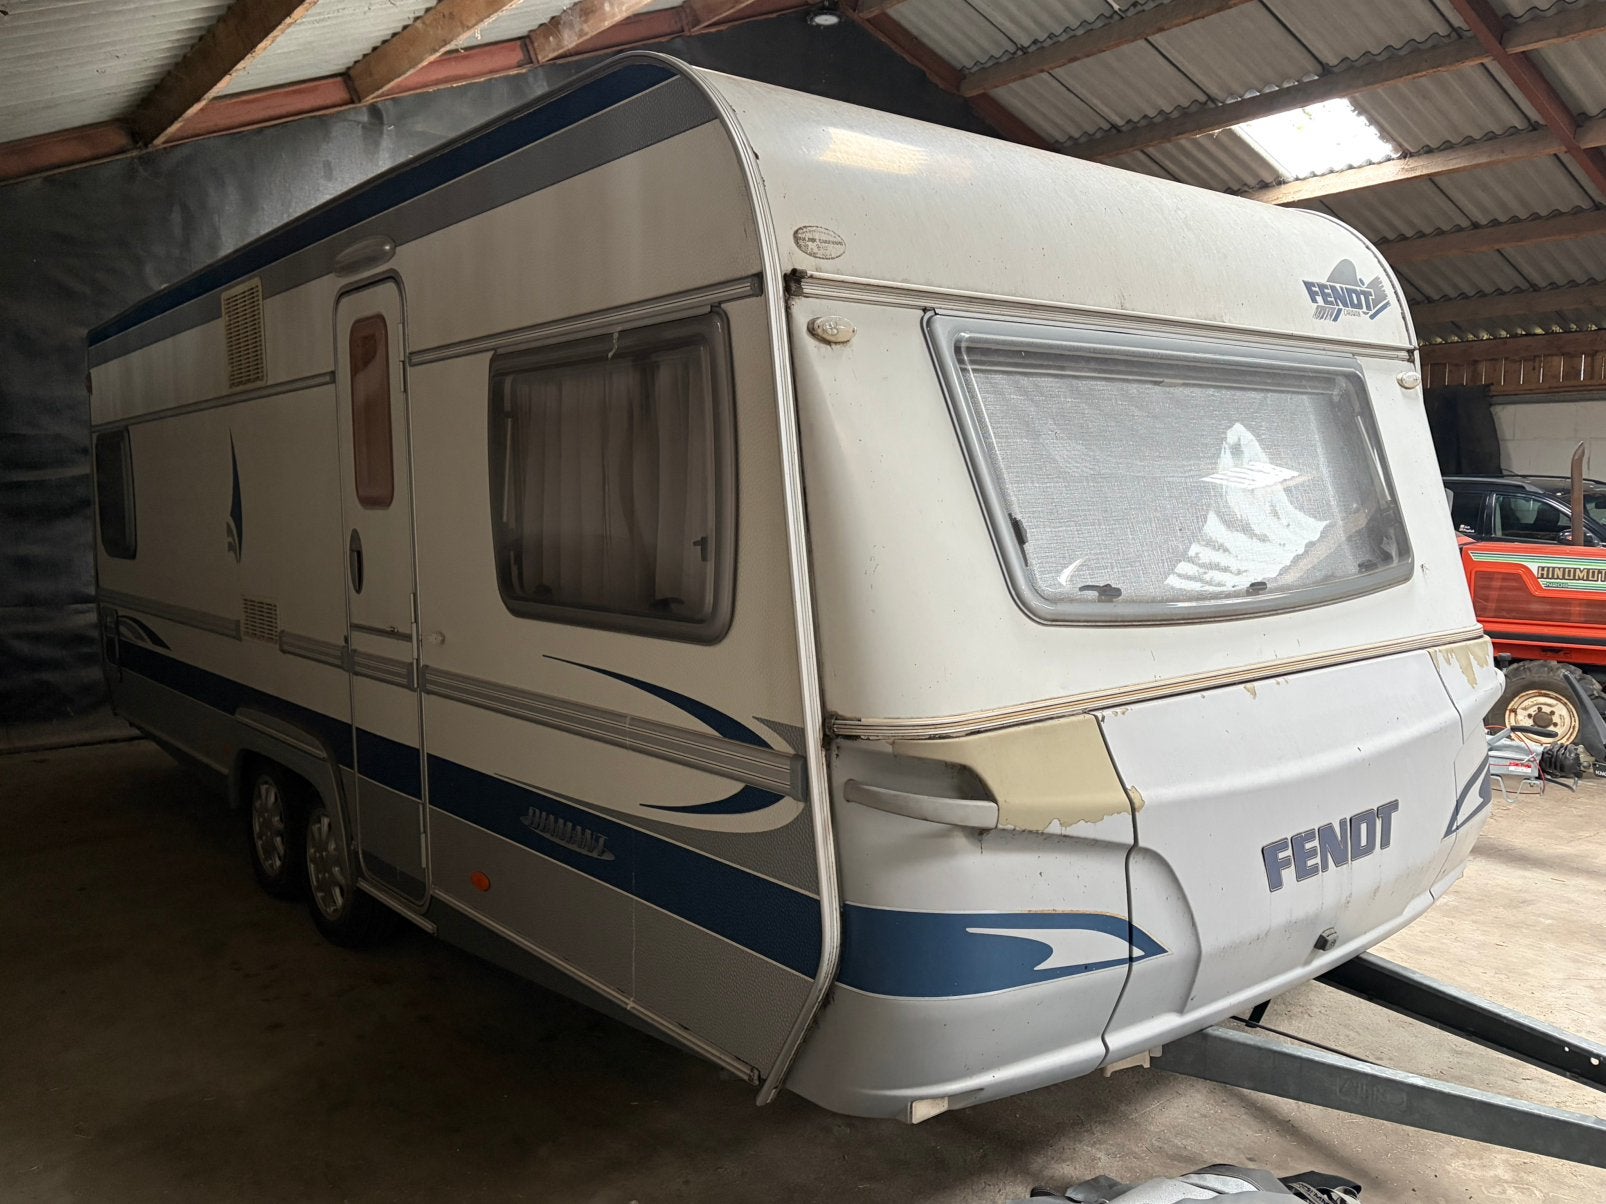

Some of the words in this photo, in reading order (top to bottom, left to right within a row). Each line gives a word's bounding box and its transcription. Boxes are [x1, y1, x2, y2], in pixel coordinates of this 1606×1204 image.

[1302, 280, 1373, 311] FENDT
[528, 806, 609, 856] DIAMANT
[1262, 799, 1399, 892] FENDT
